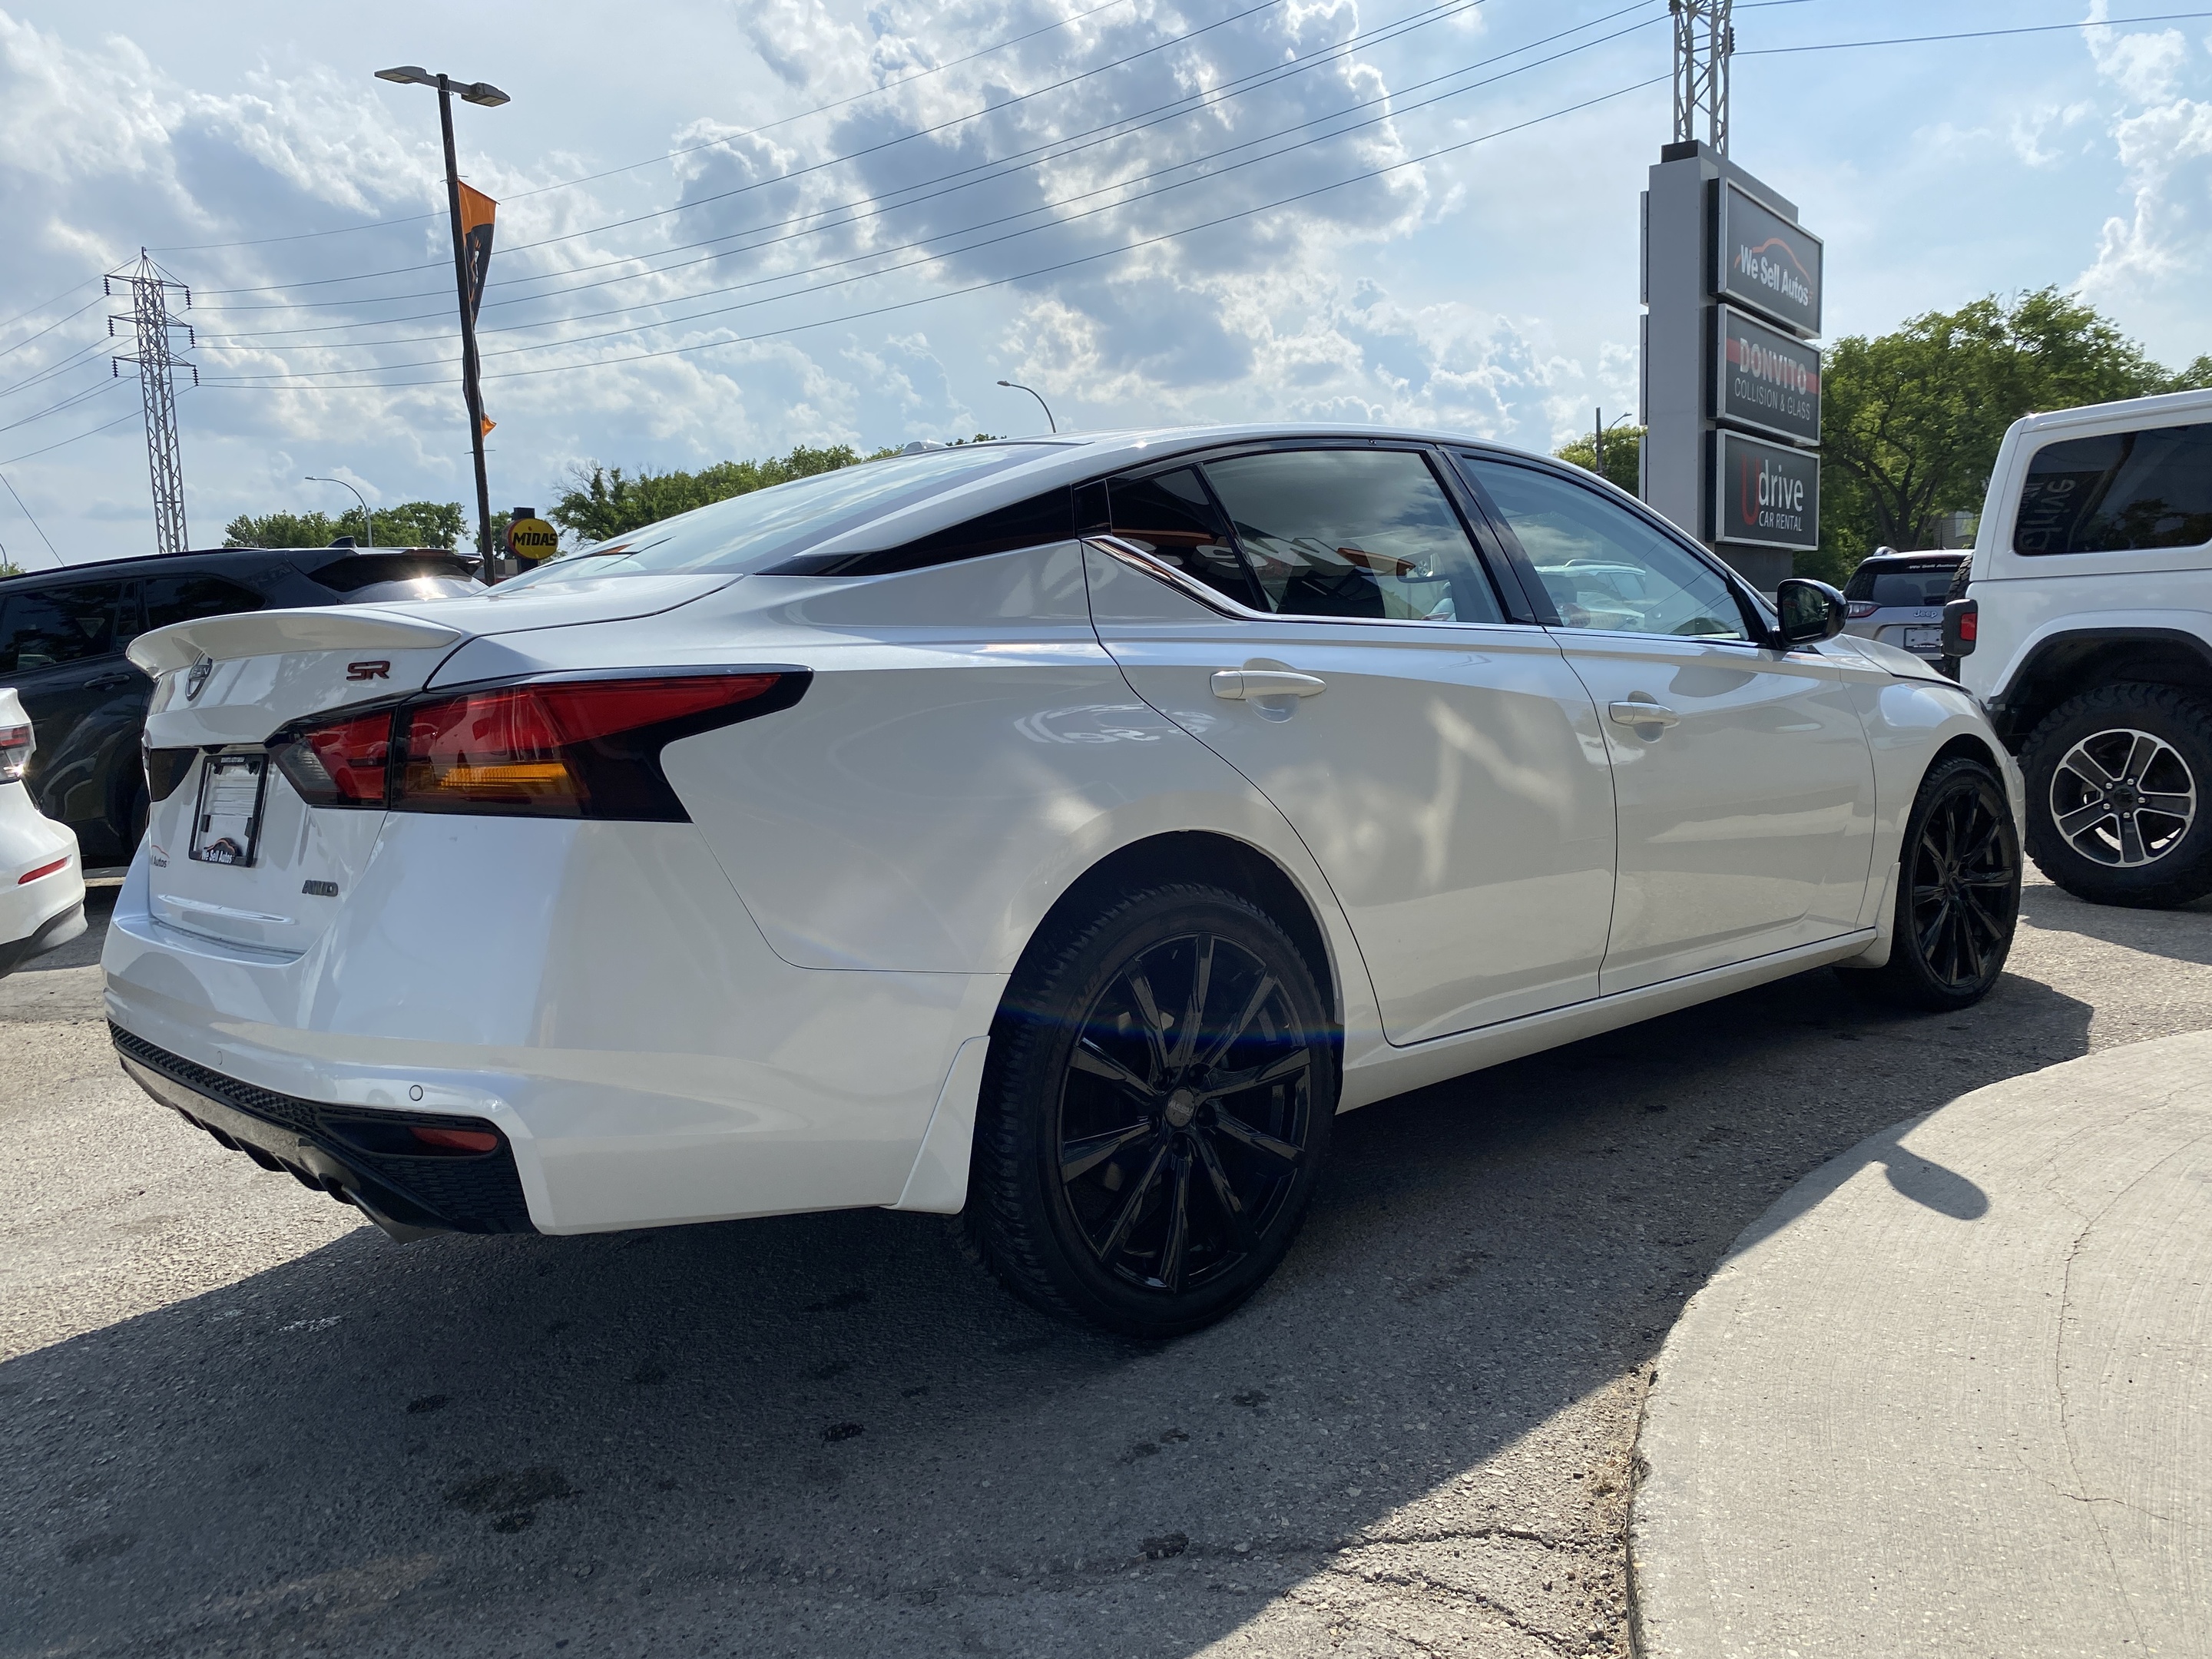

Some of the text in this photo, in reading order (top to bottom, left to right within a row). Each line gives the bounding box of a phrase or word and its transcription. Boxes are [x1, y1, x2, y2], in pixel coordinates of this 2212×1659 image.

[1740, 244, 1809, 306] We Sell Autos
[1740, 337, 1806, 396] DONVITO
[1734, 377, 1810, 421] COLLISION & GLASS
[1759, 510, 1803, 531] CAR RENTAL
[513, 532, 558, 547] MIDAS
[1913, 610, 1938, 619] Jeep
[346, 660, 390, 681] SR
[154, 855, 167, 868] Autos
[201, 848, 233, 864] We Sell Autos
[301, 879, 339, 897] AWD
